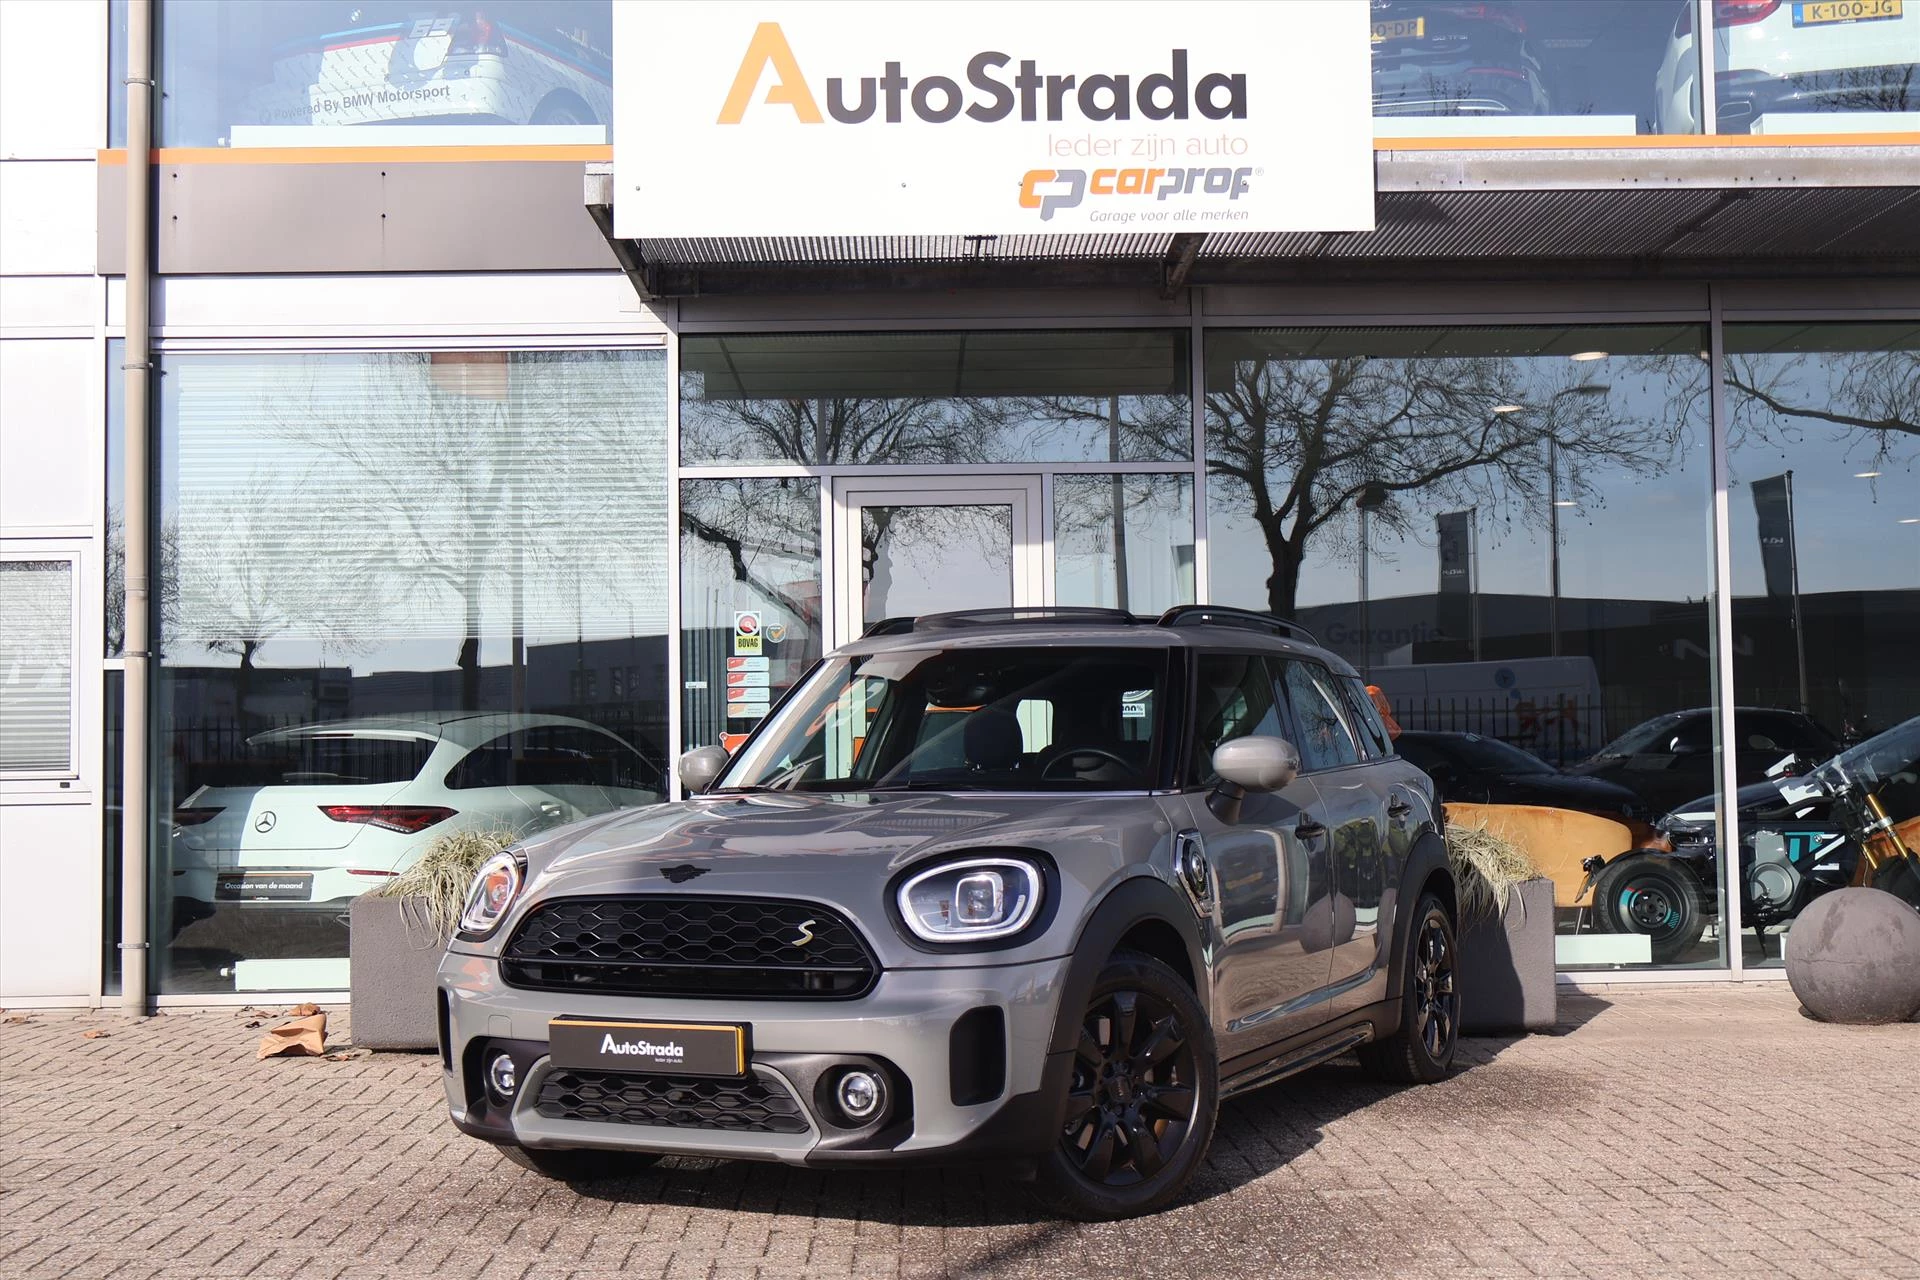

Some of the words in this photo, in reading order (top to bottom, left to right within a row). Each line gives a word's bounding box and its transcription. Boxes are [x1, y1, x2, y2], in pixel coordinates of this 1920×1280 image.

[1811, 0, 1894, 20] K-100-JG
[1371, 20, 1417, 37] 0-DP
[716, 22, 1247, 124] AutoStrada
[274, 101, 321, 120] Powered
[324, 99, 339, 113] By
[343, 94, 374, 109] BMW
[377, 85, 451, 104] Motorsport
[1048, 133, 1122, 156] Ieder
[1130, 133, 1175, 163] zijn
[1185, 134, 1248, 156] auto
[1090, 210, 1135, 224] Garage
[1141, 211, 1169, 221] voor
[1174, 209, 1197, 221] alle
[1201, 209, 1249, 221] merken
[738, 638, 758, 648] BOVAG
[1325, 621, 1446, 645] Garantie
[225, 882, 254, 890] Occasion
[269, 881, 277, 890] de
[278, 882, 304, 890] maand
[792, 920, 816, 946] S
[600, 1034, 684, 1058] AutoStrada
